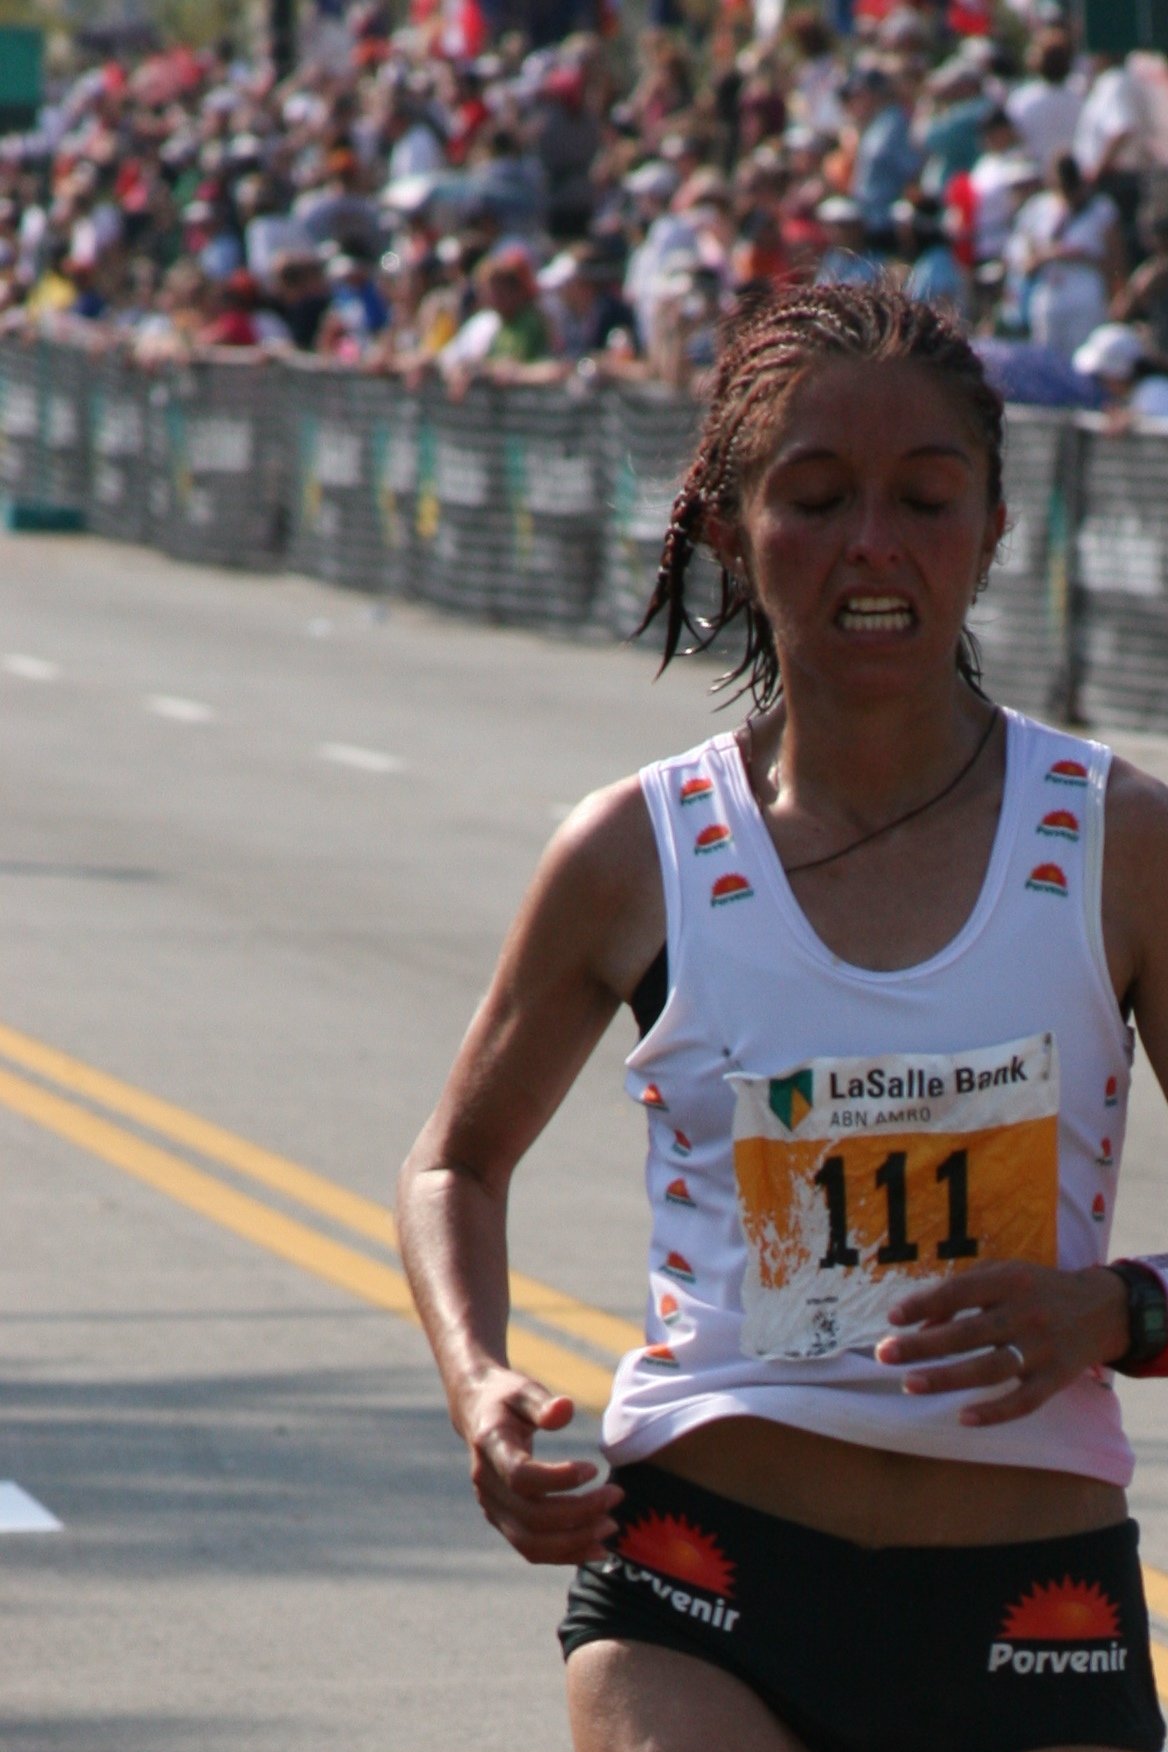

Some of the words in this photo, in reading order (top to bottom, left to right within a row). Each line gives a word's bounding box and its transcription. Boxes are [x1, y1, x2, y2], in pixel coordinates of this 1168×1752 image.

[829, 1068, 944, 1099] LaSalle
[955, 1056, 1028, 1094] Bank
[830, 1110, 868, 1128] ABN
[874, 1107, 931, 1126] AMRO
[815, 1148, 978, 1268] 111
[980, 1640, 1128, 1674] Porvenir
